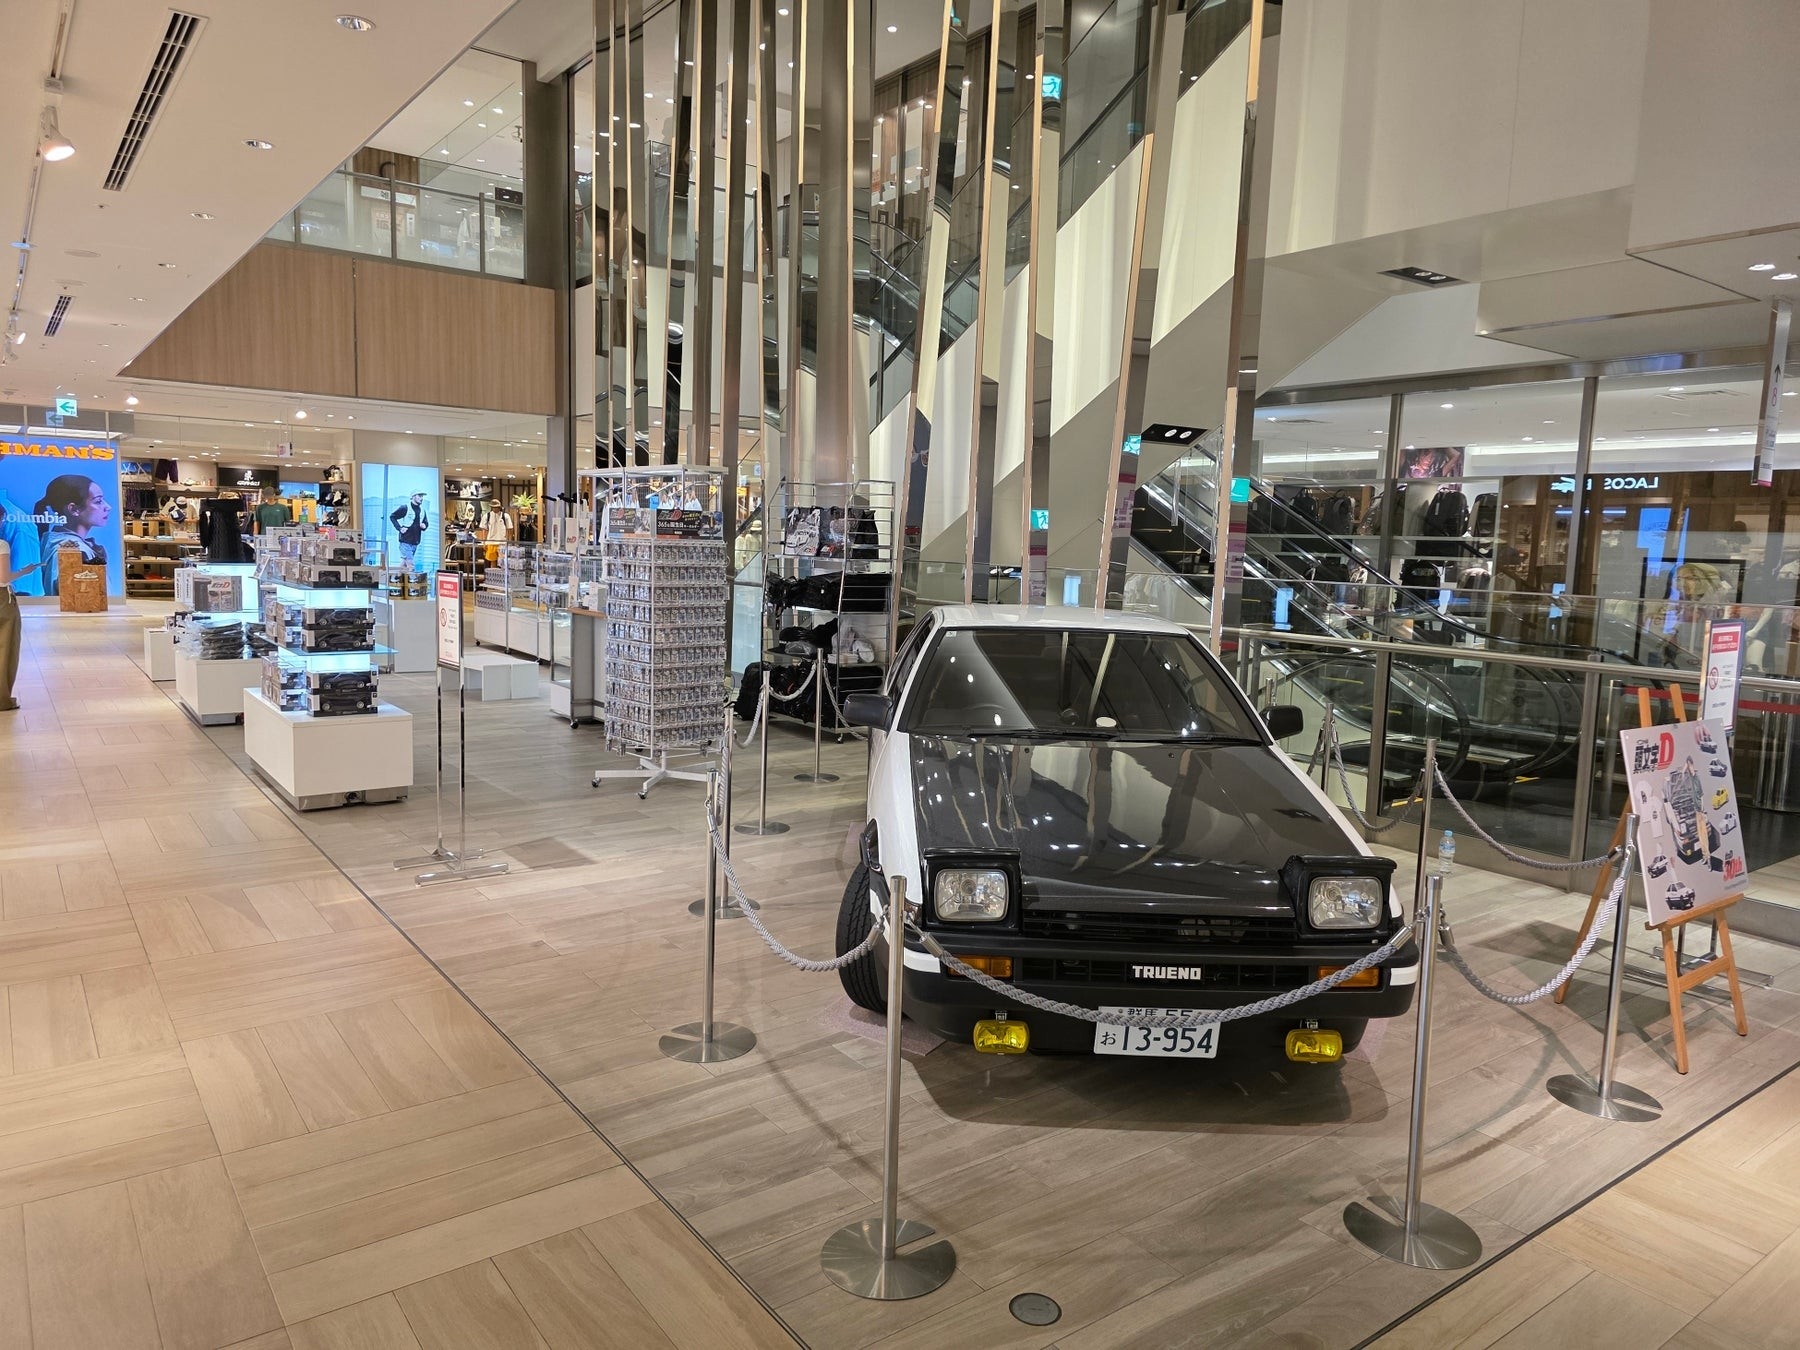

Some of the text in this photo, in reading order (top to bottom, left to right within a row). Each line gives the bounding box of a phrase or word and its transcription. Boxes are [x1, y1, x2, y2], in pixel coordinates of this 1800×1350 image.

[1132, 965, 1202, 980] TRUENO
[1100, 1026, 1214, 1054] お 13-954
